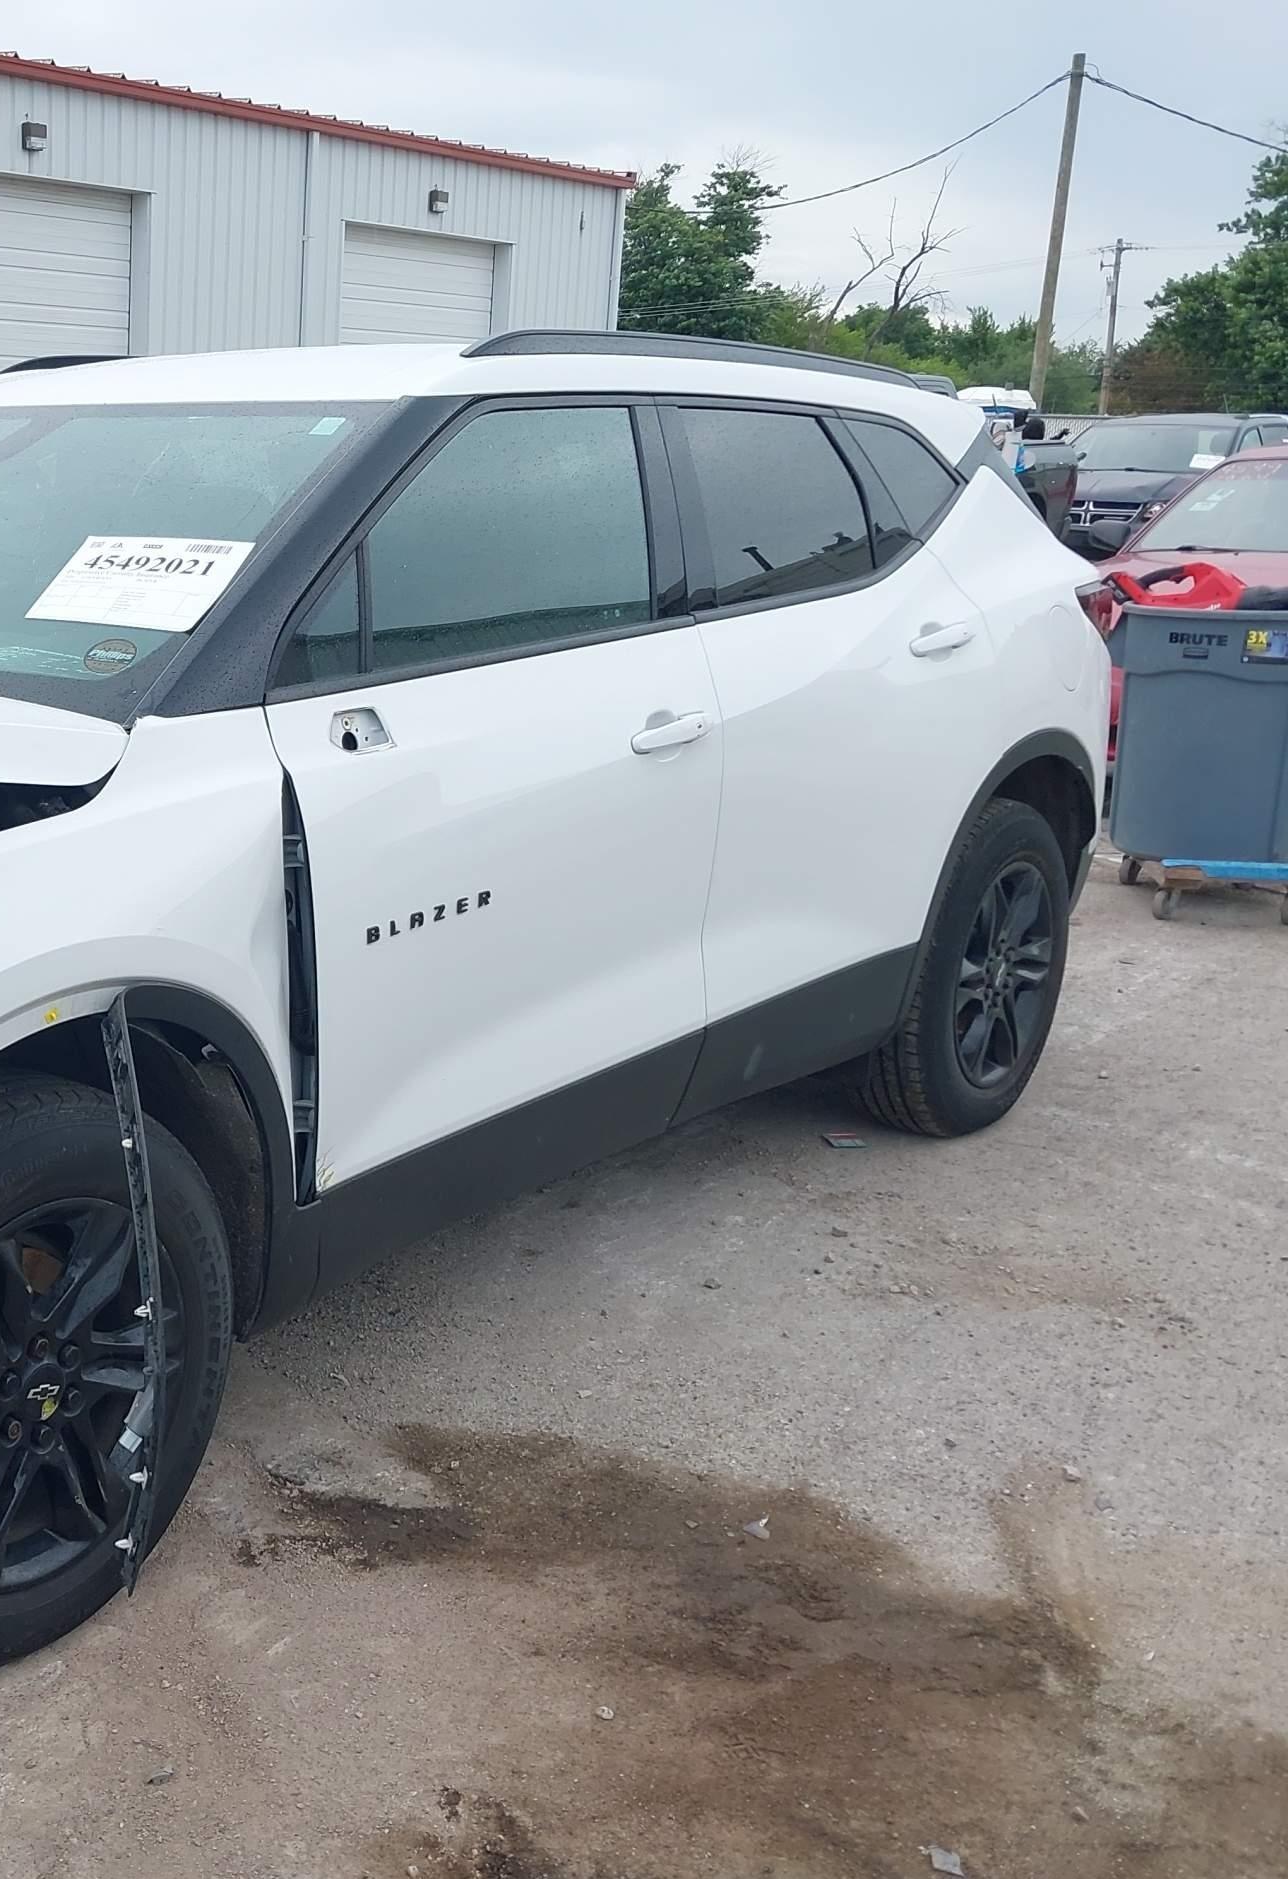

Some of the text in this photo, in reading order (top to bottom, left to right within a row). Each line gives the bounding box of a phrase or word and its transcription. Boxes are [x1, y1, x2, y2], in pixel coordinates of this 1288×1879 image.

[84, 554, 216, 577] 45492021
[1168, 632, 1228, 646] BRUTE
[1247, 630, 1268, 644] 3X
[366, 890, 492, 945] BLAZER
